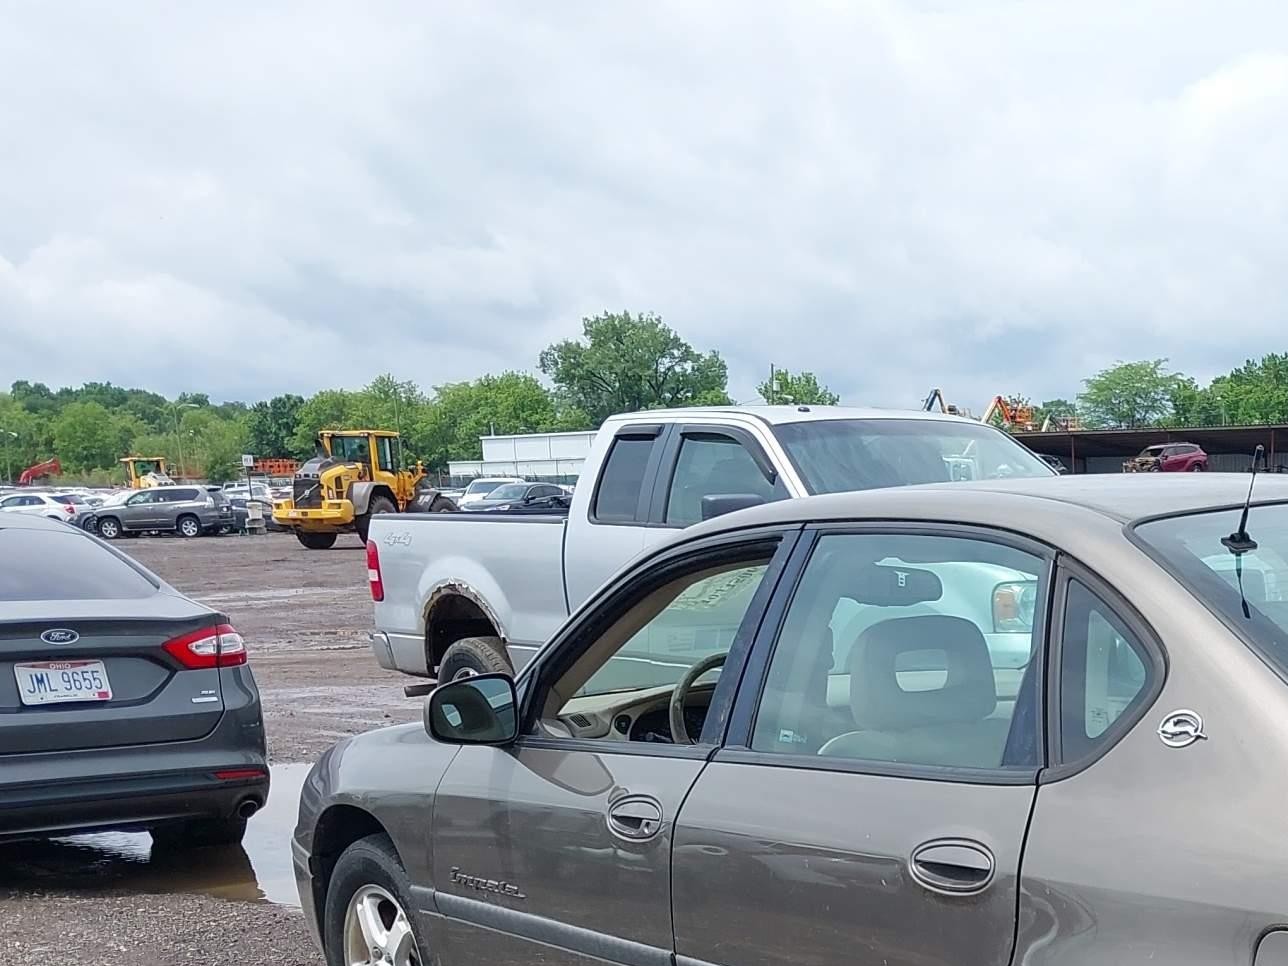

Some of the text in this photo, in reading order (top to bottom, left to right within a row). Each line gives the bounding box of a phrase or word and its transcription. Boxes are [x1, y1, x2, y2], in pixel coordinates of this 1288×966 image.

[27, 670, 103, 694] JML 9655
[450, 866, 526, 899] Impala
